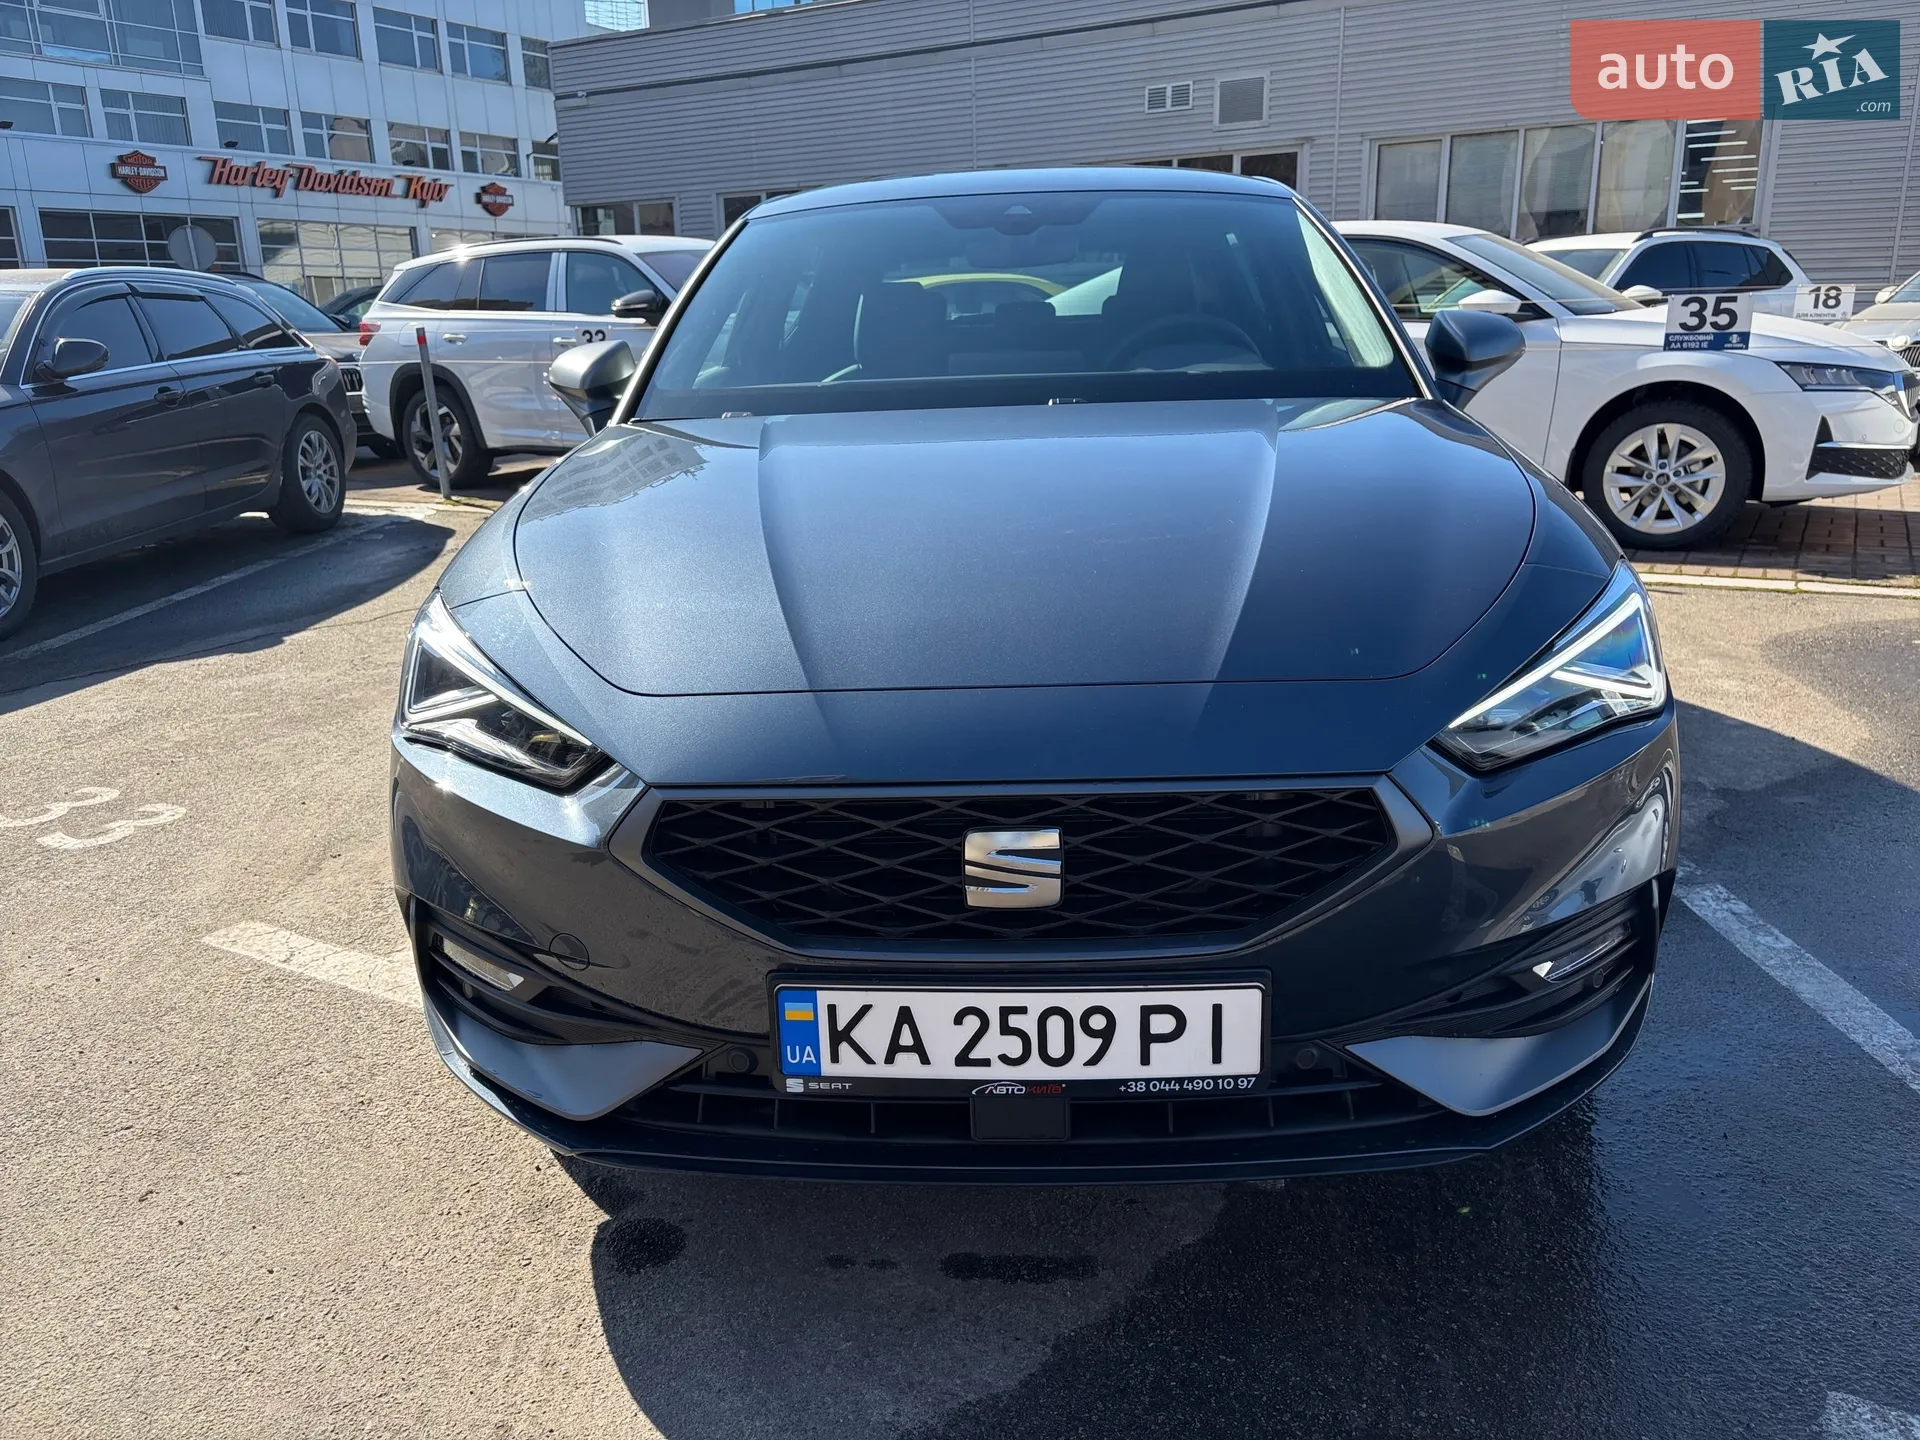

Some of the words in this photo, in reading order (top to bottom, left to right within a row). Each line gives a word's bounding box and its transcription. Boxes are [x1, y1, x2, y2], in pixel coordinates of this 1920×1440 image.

[1808, 286, 1842, 309] 18
[1678, 296, 1738, 332] 35
[826, 1003, 932, 1066] KA
[953, 1005, 1117, 1068] 2509
[786, 1045, 817, 1064] UA
[808, 1082, 853, 1090] SEAT
[1118, 1081, 1146, 1092] +38
[1149, 1080, 1180, 1092] 044
[1183, 1079, 1214, 1091] 490
[1217, 1078, 1235, 1090] 10
[1237, 1077, 1256, 1090] 97
